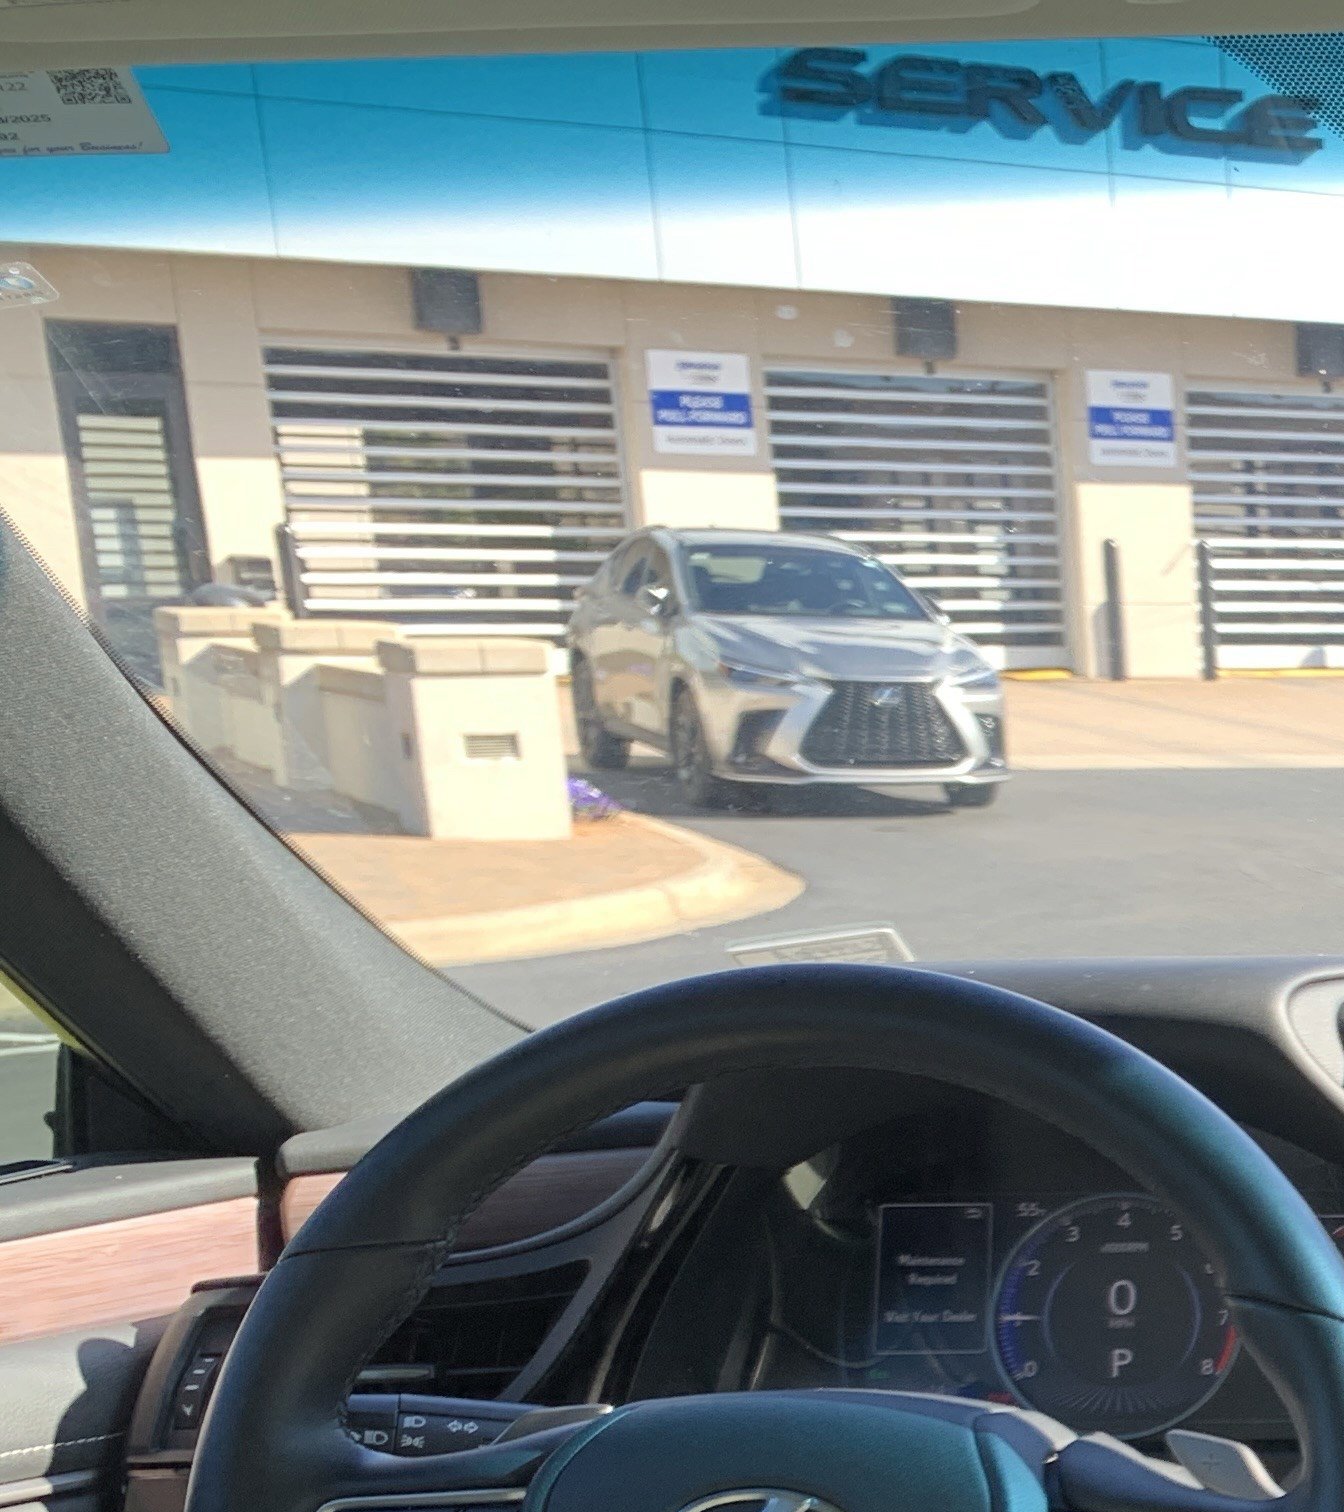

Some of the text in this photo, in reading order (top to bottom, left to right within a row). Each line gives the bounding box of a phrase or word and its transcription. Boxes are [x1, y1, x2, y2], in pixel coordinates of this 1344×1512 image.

[768, 46, 1323, 152] SERVICE
[1117, 1212, 1132, 1229] 4
[1065, 1225, 1081, 1242] 3
[1170, 1224, 1183, 1242] 5
[1026, 1260, 1041, 1276] 2
[1107, 1279, 1137, 1316] 0
[1111, 1348, 1134, 1378] P
[1200, 1358, 1215, 1376] 8
